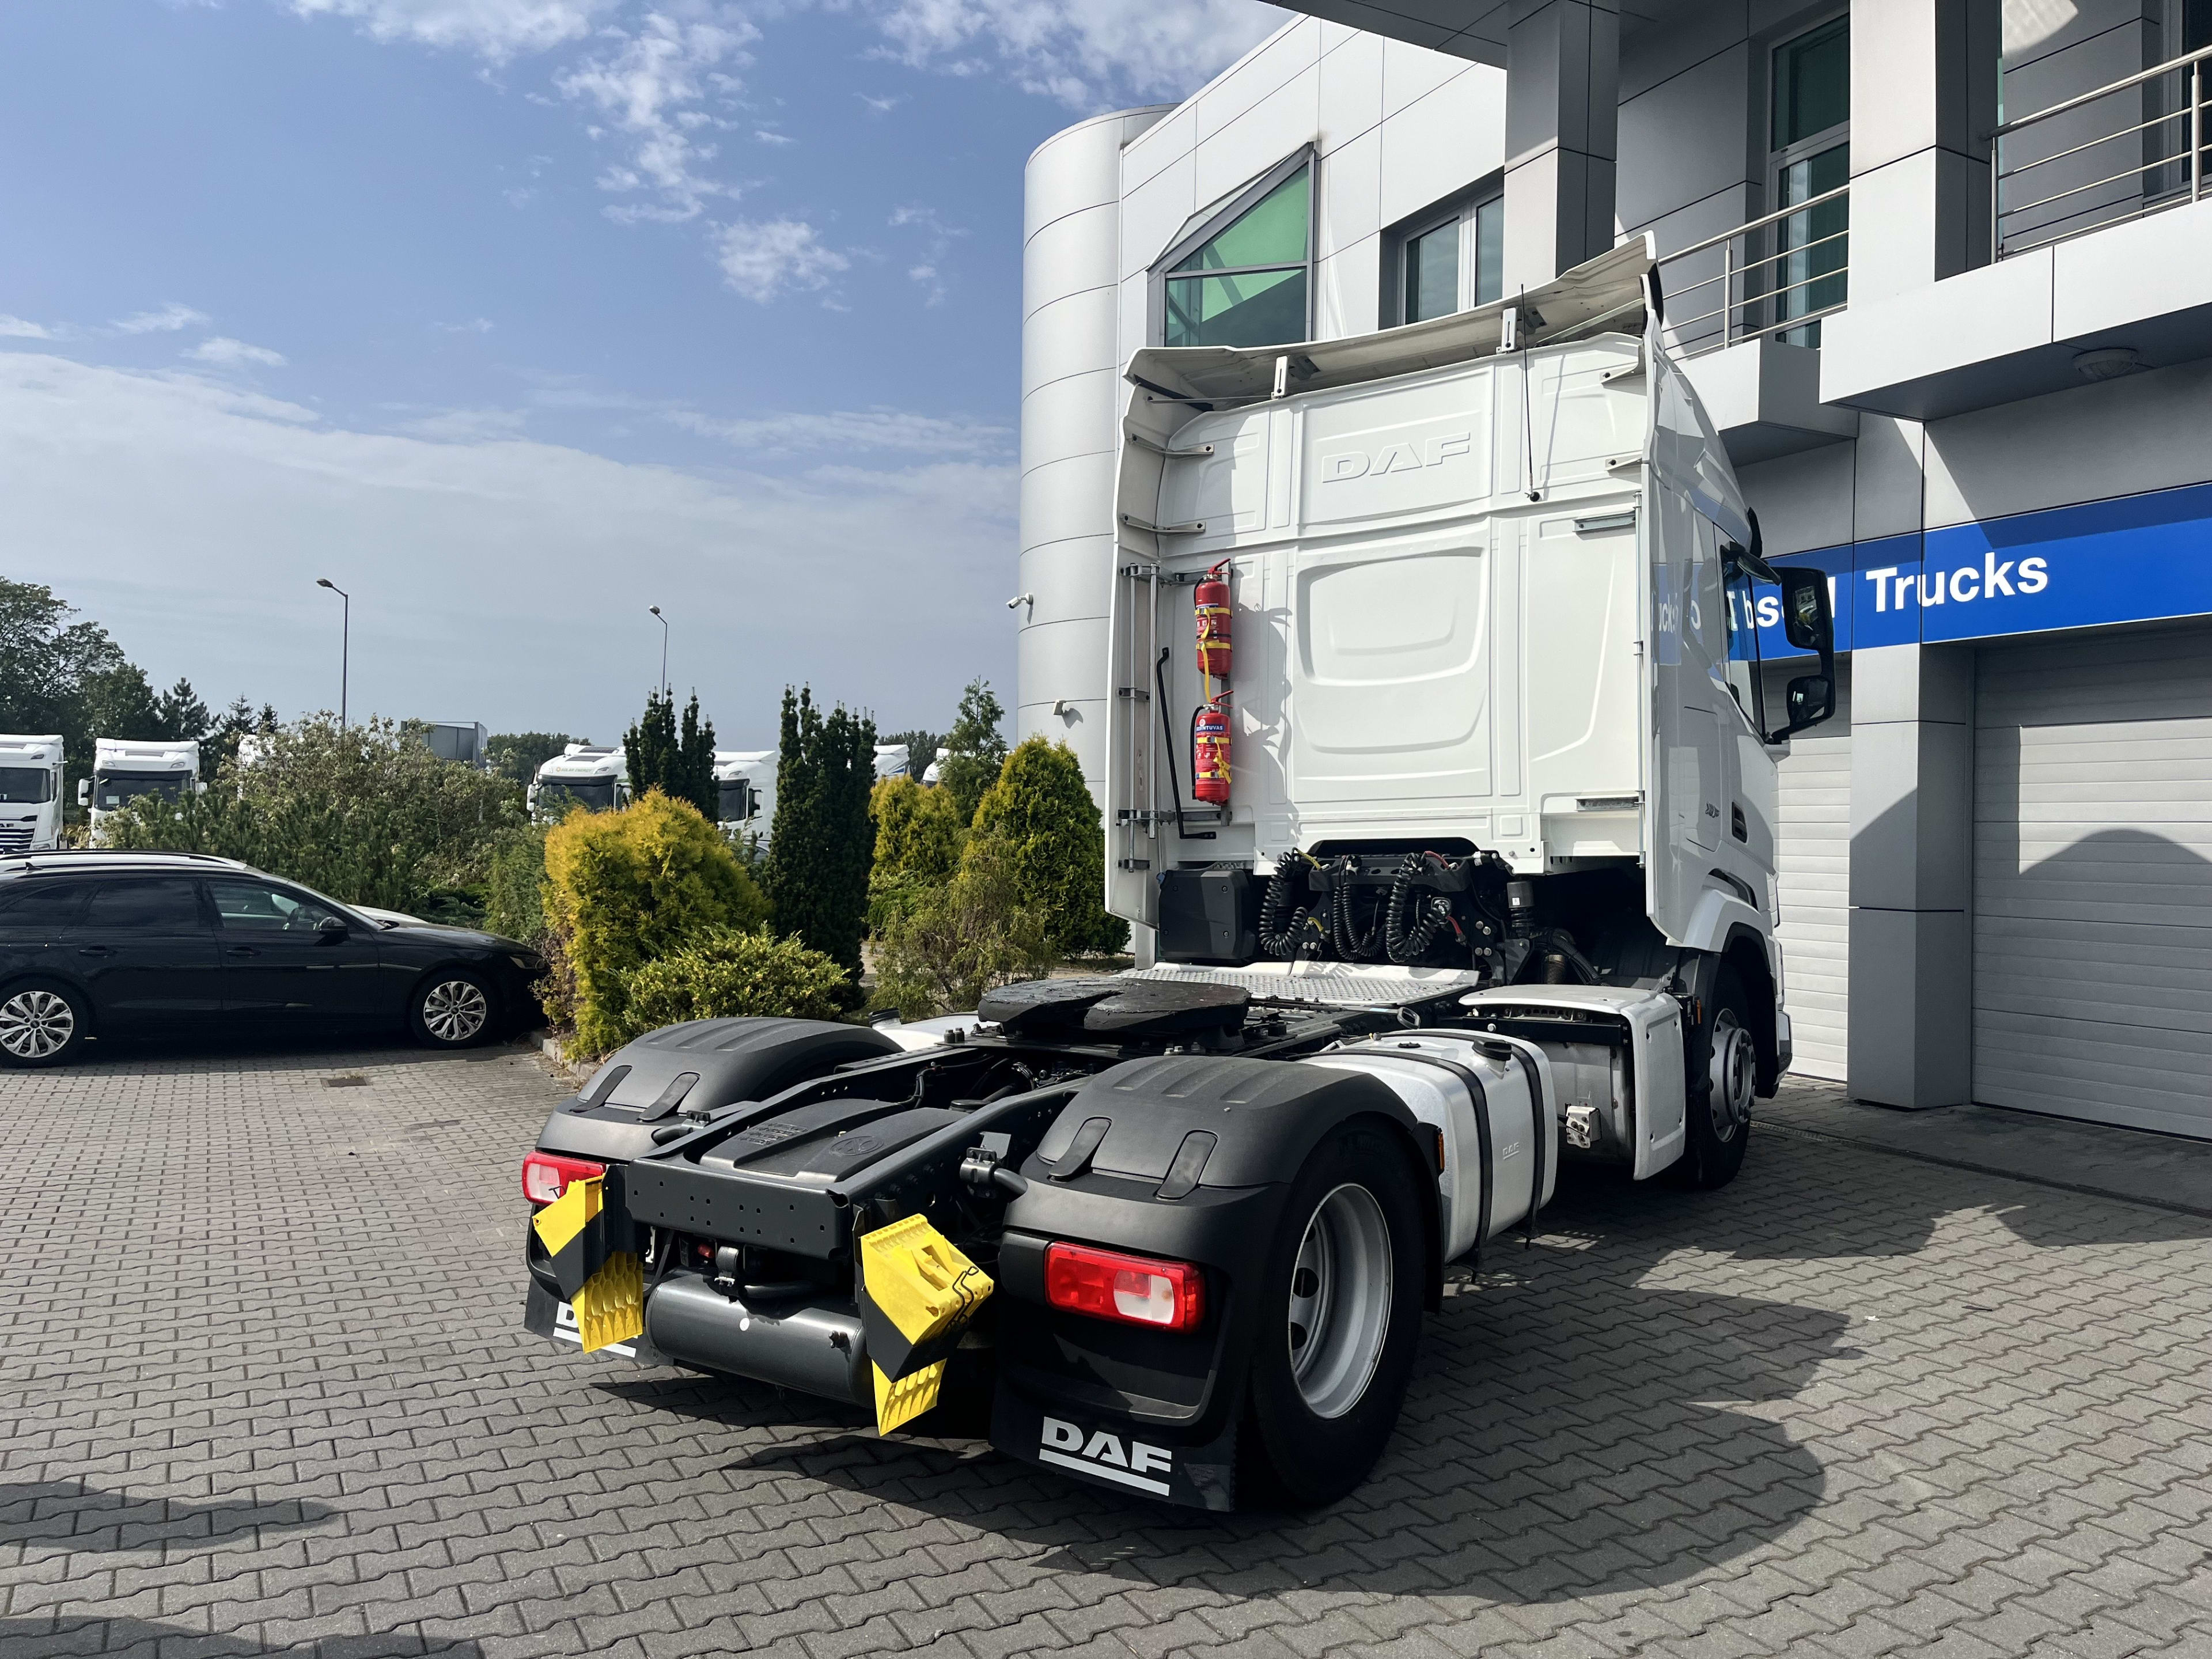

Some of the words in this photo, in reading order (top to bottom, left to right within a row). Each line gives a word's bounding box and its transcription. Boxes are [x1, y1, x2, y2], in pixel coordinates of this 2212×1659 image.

[1322, 431, 1471, 483] DAF
[1866, 552, 2048, 612] Trucks
[1041, 1416, 1172, 1473] DAF
